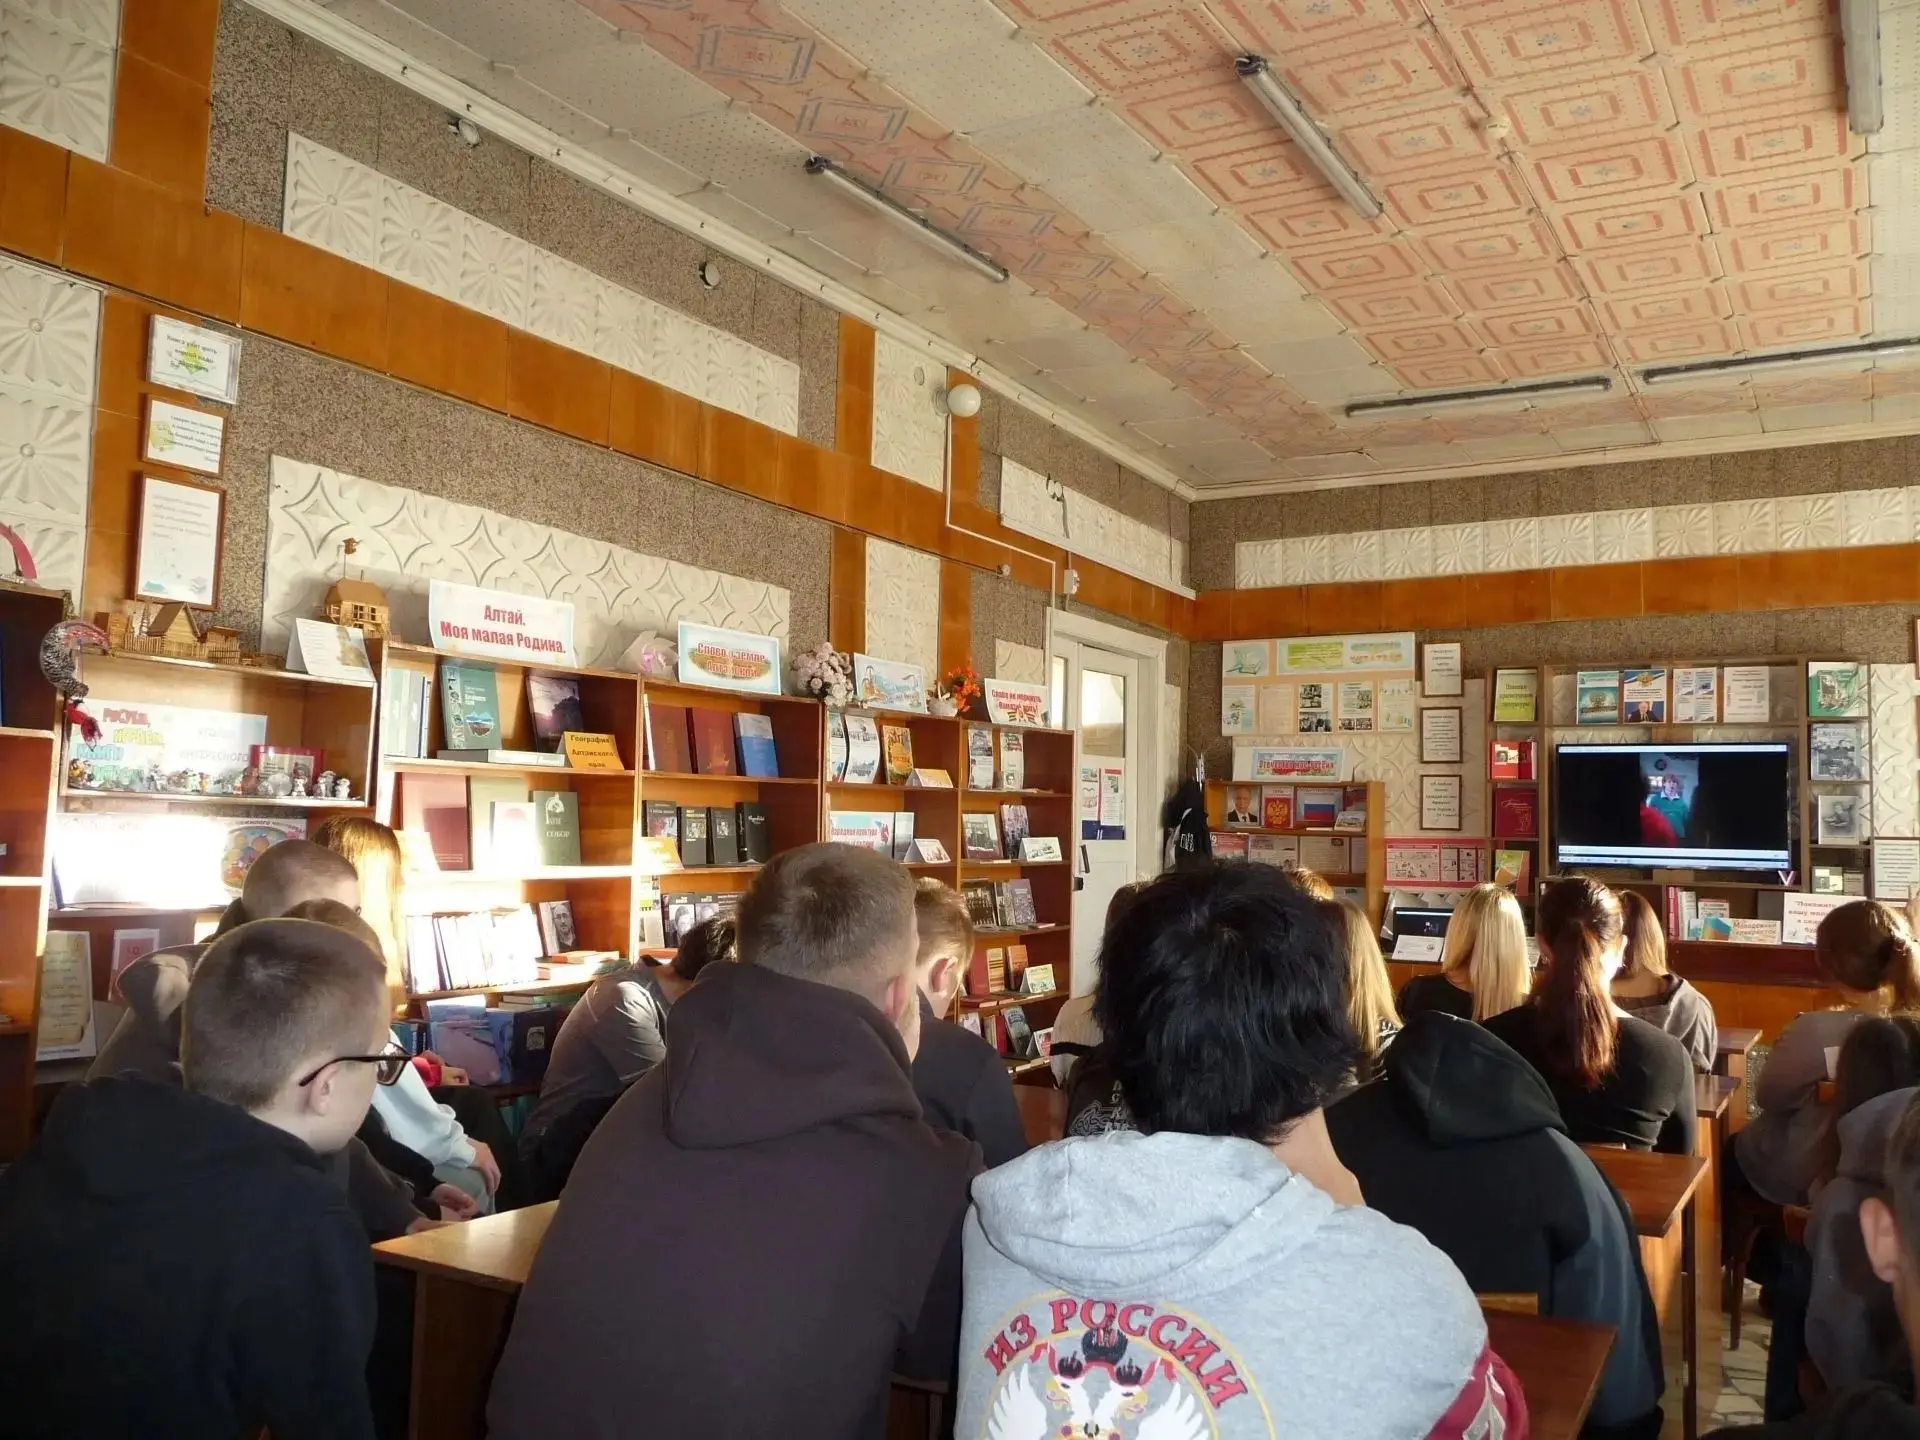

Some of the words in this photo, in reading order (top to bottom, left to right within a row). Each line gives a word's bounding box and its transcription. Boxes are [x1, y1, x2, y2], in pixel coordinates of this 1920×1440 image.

[484, 604, 526, 626] Алтай.
[440, 621, 469, 640] Моя
[472, 628, 515, 646] малая
[516, 632, 567, 653] Родина.
[697, 643, 726, 657] Слово
[570, 734, 610, 744] География
[984, 1314, 1038, 1377] ИЗ
[1048, 1298, 1249, 1410] РОССИИ
